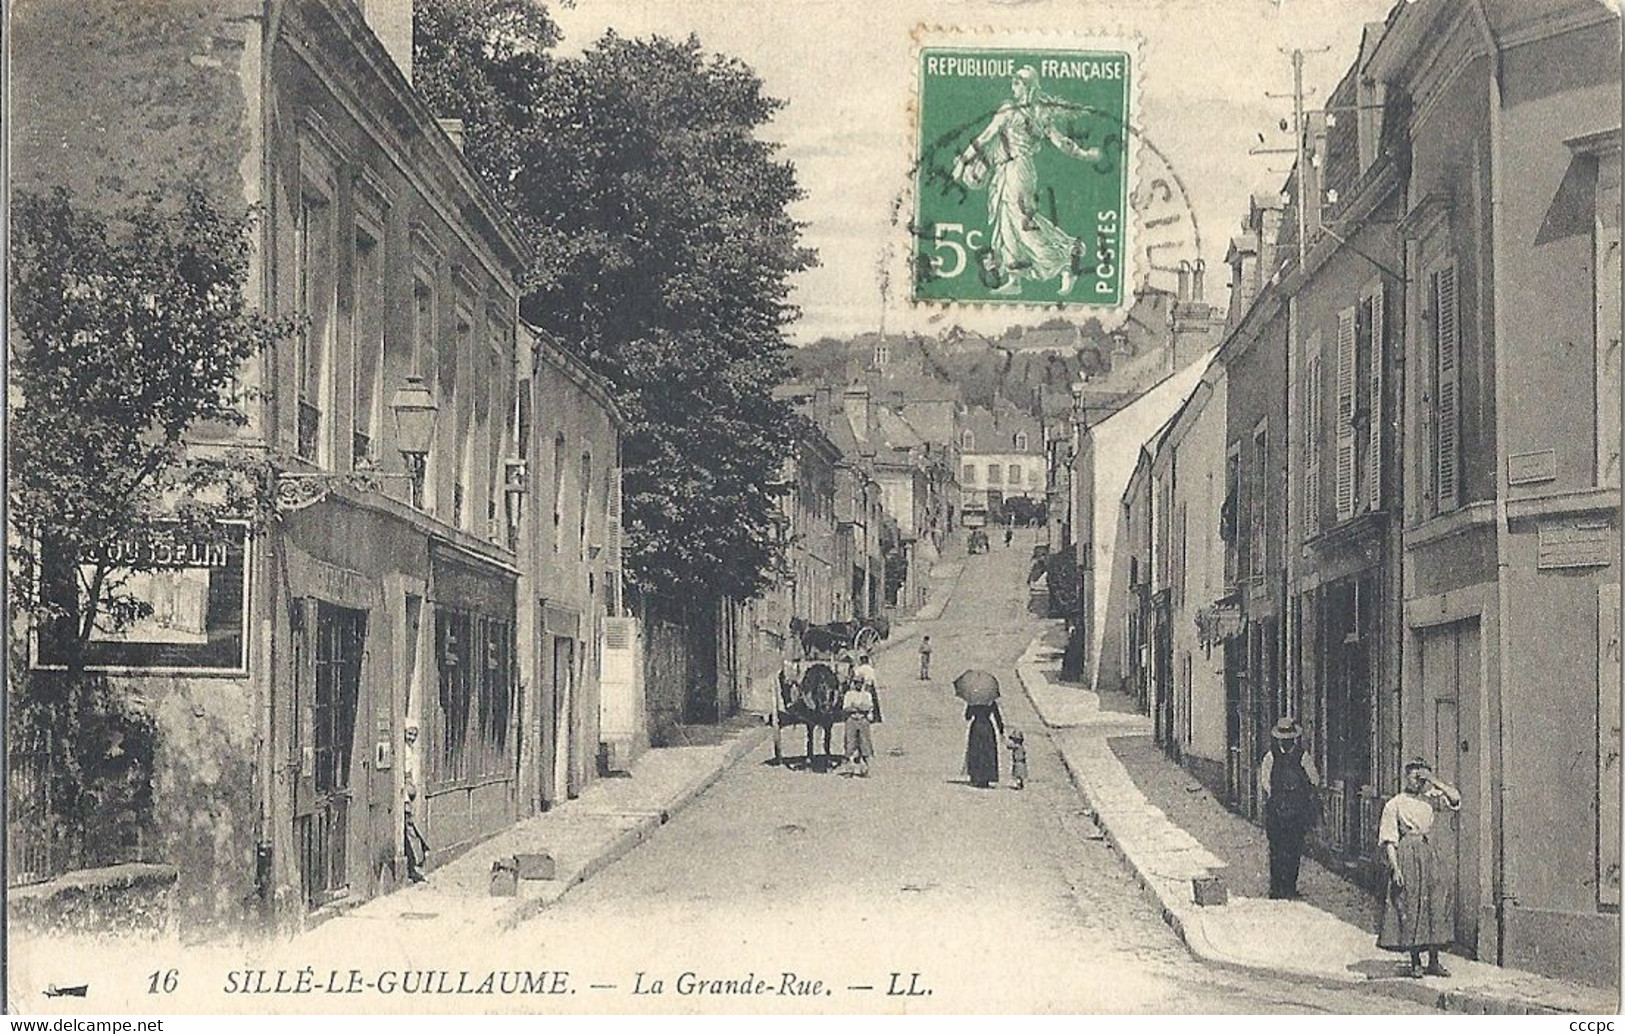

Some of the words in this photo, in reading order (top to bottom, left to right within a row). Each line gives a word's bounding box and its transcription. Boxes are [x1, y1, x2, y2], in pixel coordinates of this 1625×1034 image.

[927, 57, 1015, 79] REPUBLIQUE
[1041, 60, 1122, 82] FRANÇAISE
[1095, 209, 1117, 294] POSTES
